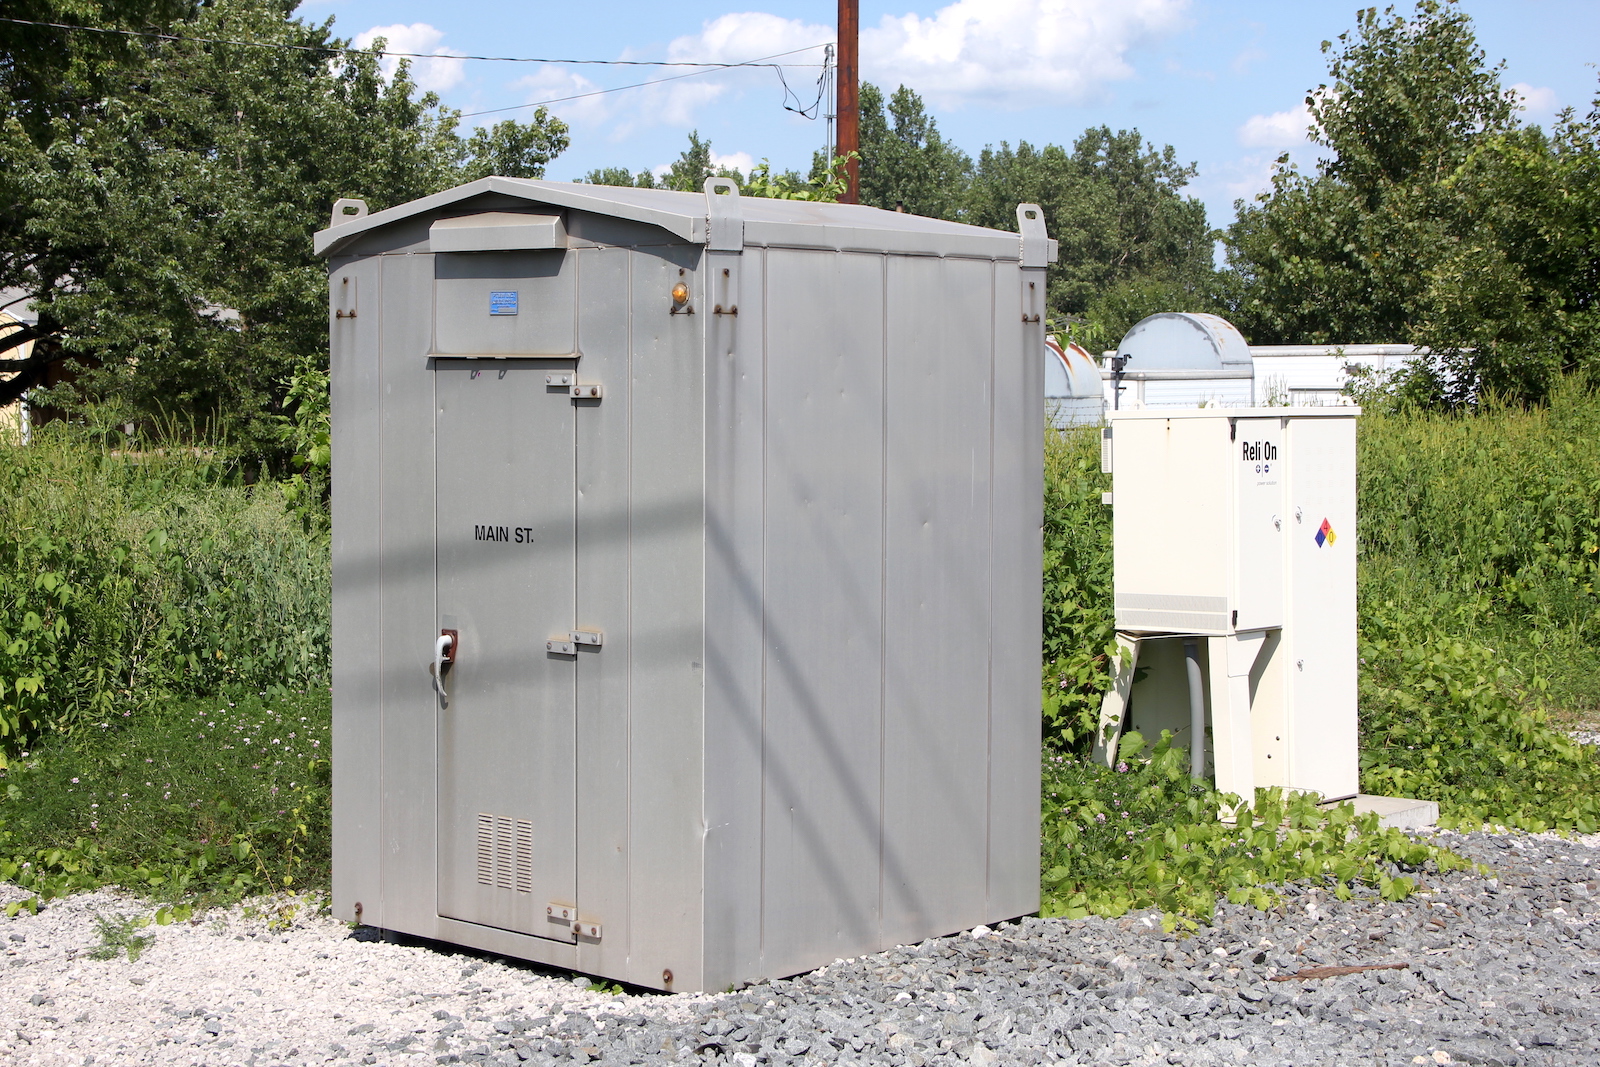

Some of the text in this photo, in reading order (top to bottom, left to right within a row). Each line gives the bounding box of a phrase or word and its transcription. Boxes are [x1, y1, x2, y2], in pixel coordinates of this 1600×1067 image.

[1323, 520, 1328, 532] 4
[475, 525, 534, 543] MAIN ST.
[1329, 531, 1334, 543] 0
